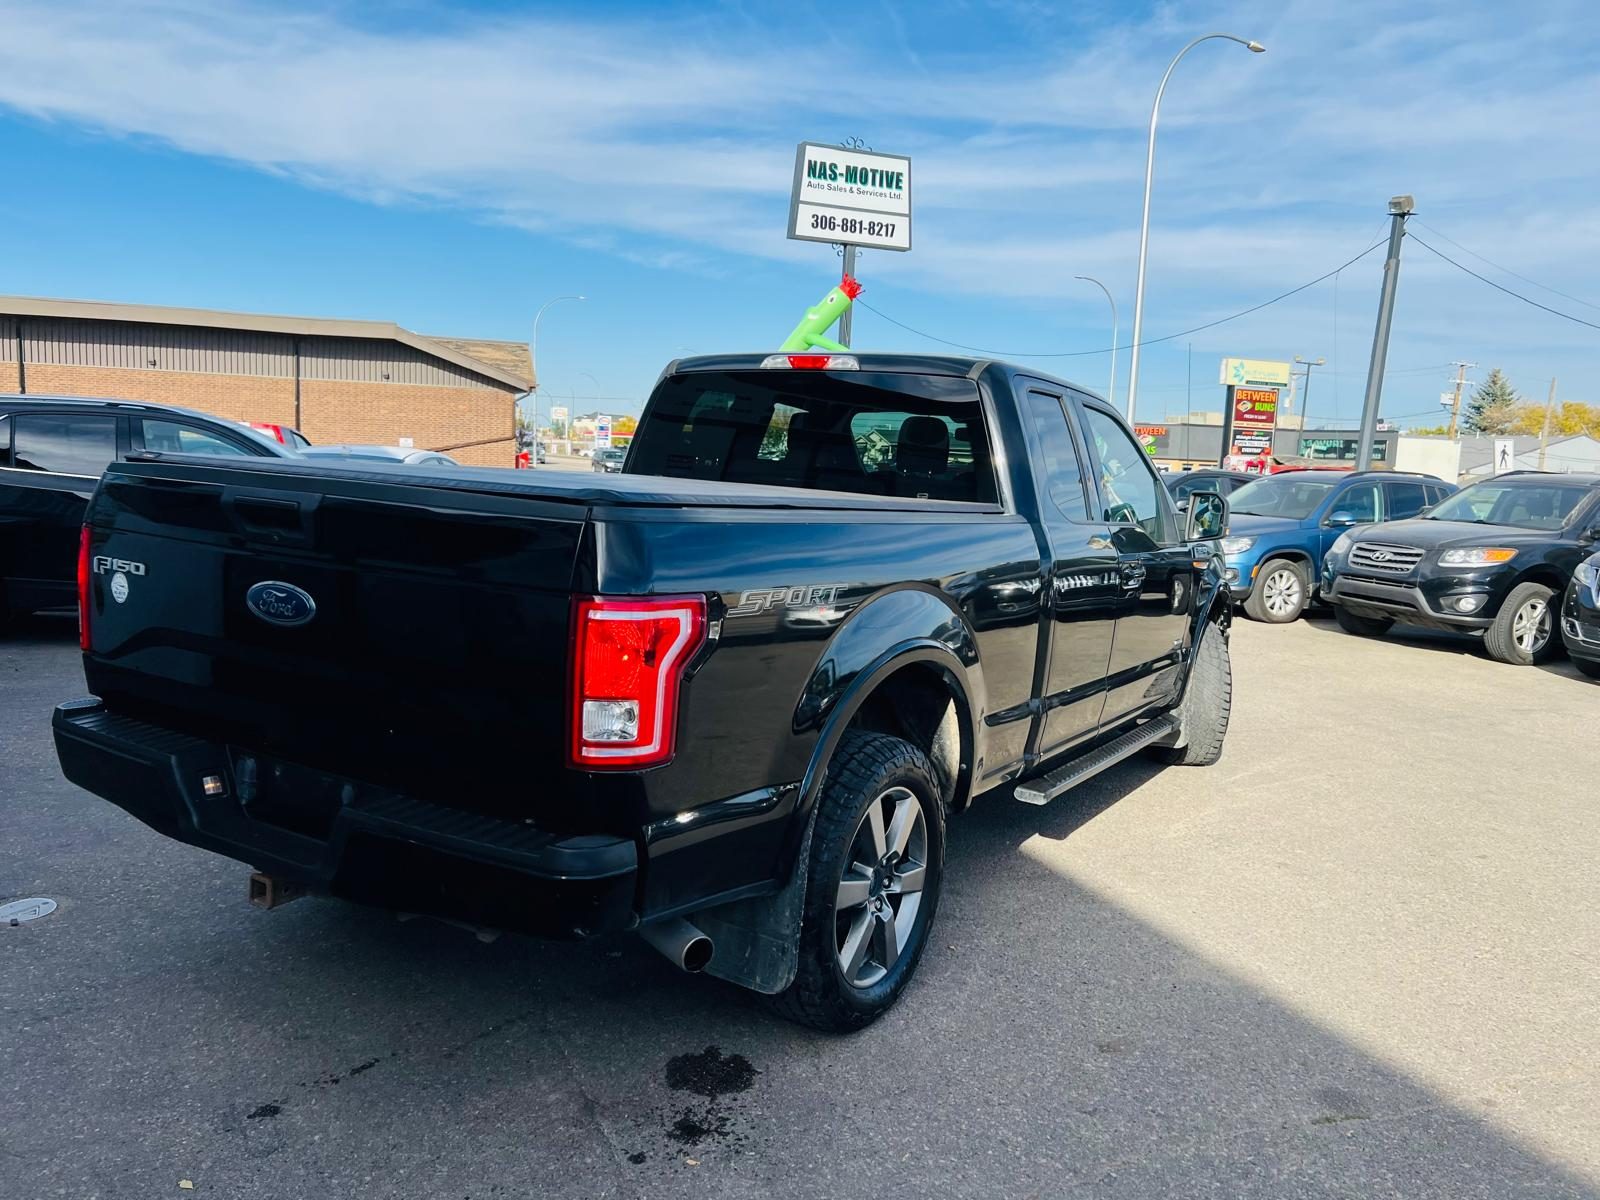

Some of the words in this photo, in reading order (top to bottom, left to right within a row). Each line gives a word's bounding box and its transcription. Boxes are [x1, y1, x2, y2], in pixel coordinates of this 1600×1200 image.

[807, 159, 903, 190] NAS-MOTIVE
[807, 181, 825, 190] Auto
[826, 183, 847, 193] Sales
[849, 186, 855, 194] &
[856, 187, 888, 198] Services
[889, 192, 903, 200] Ltd.
[811, 214, 896, 238] 306-881-8217
[1237, 390, 1276, 402] BETWEEN
[1255, 402, 1275, 412] BUNS
[1134, 427, 1166, 435] TWEEN
[259, 589, 297, 616] Ford
[726, 583, 849, 618] SPORT
